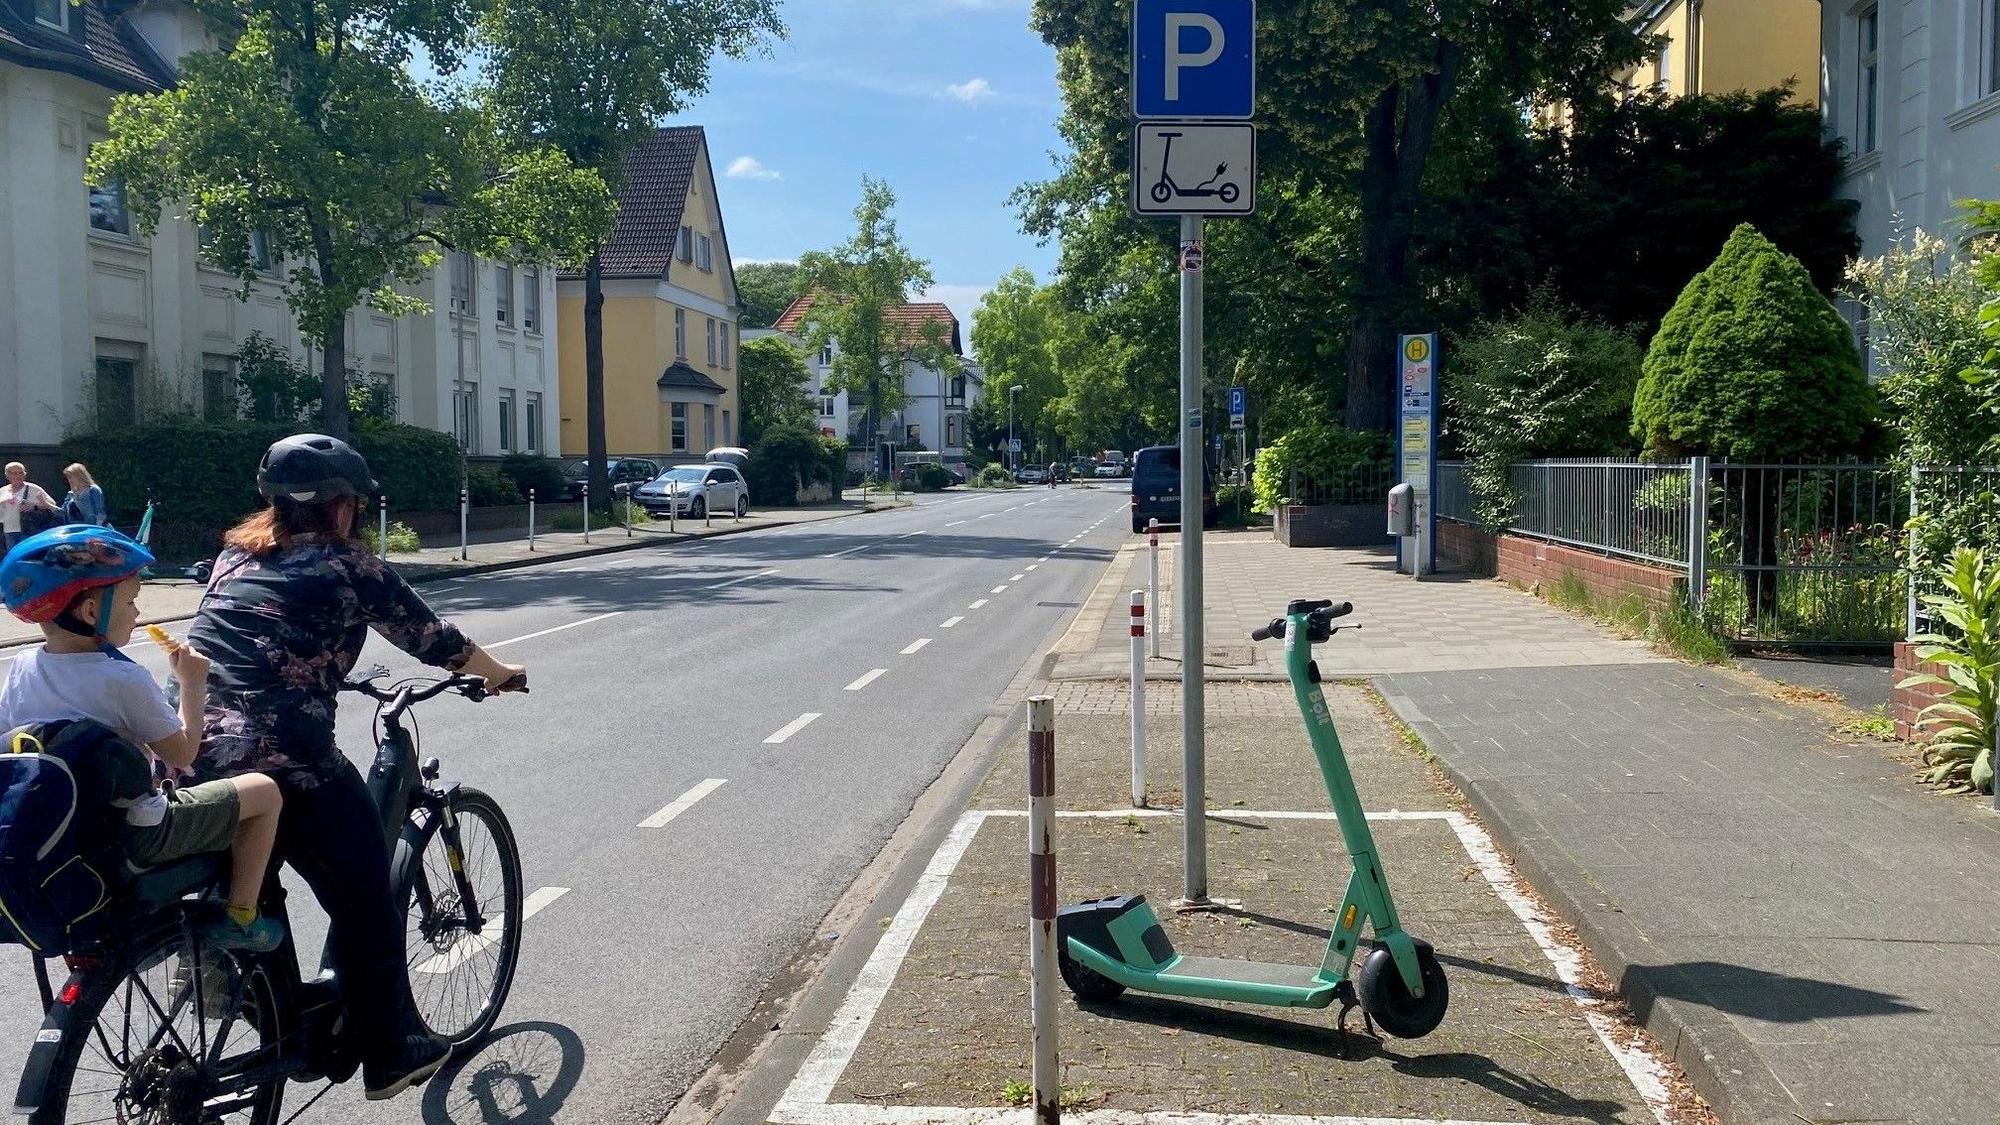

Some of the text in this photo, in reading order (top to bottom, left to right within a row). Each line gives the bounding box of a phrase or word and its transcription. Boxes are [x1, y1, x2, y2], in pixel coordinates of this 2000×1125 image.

[1164, 12, 1225, 101] P
[1412, 341, 1422, 358] H
[1233, 391, 1241, 412] P
